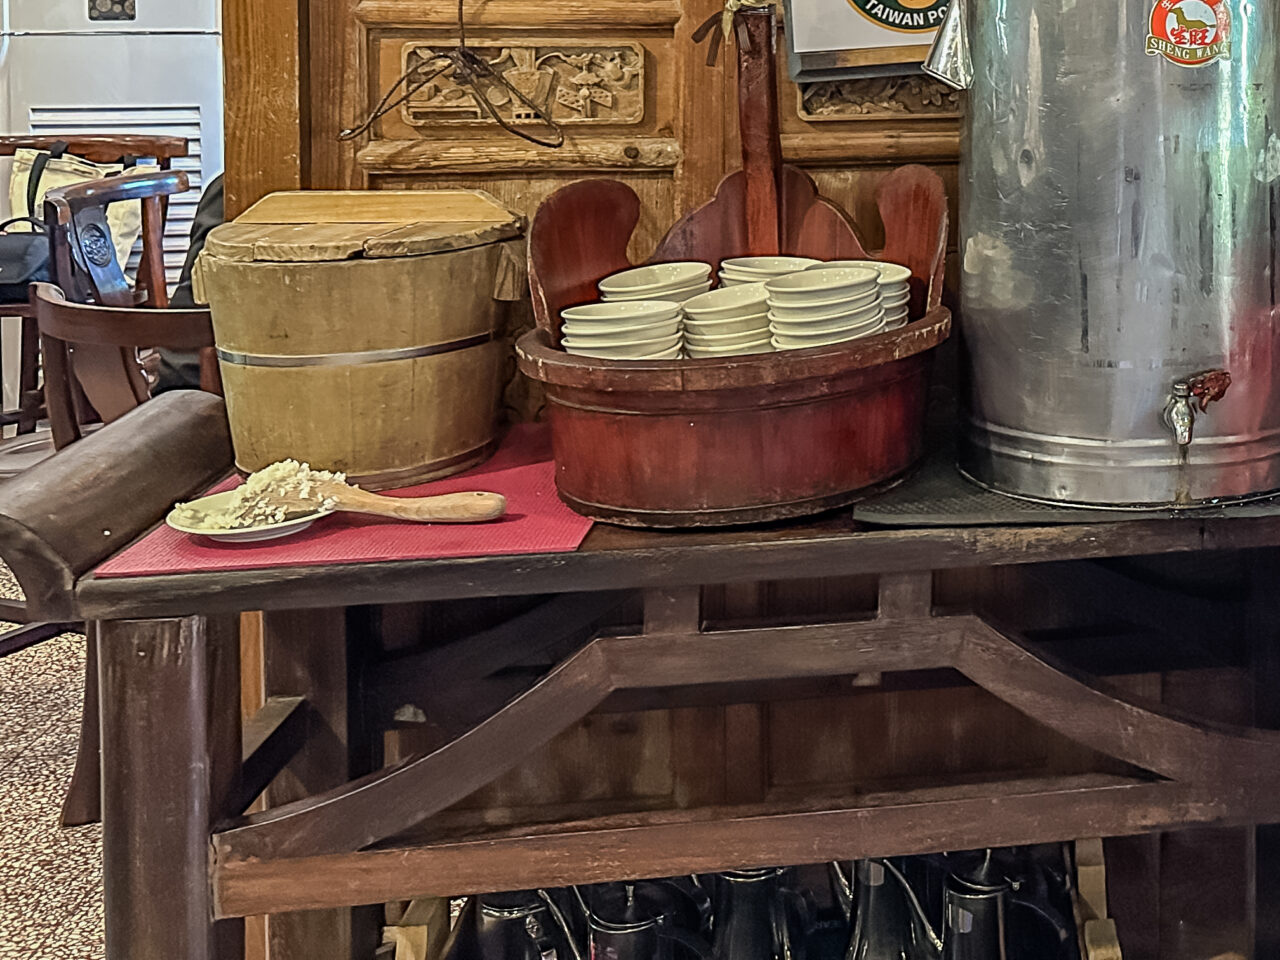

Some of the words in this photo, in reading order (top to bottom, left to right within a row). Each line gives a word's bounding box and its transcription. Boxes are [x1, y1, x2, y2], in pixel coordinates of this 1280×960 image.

[927, 3, 950, 24] PO
[1150, 38, 1190, 59] SHENG
[1196, 42, 1228, 58] WANG
